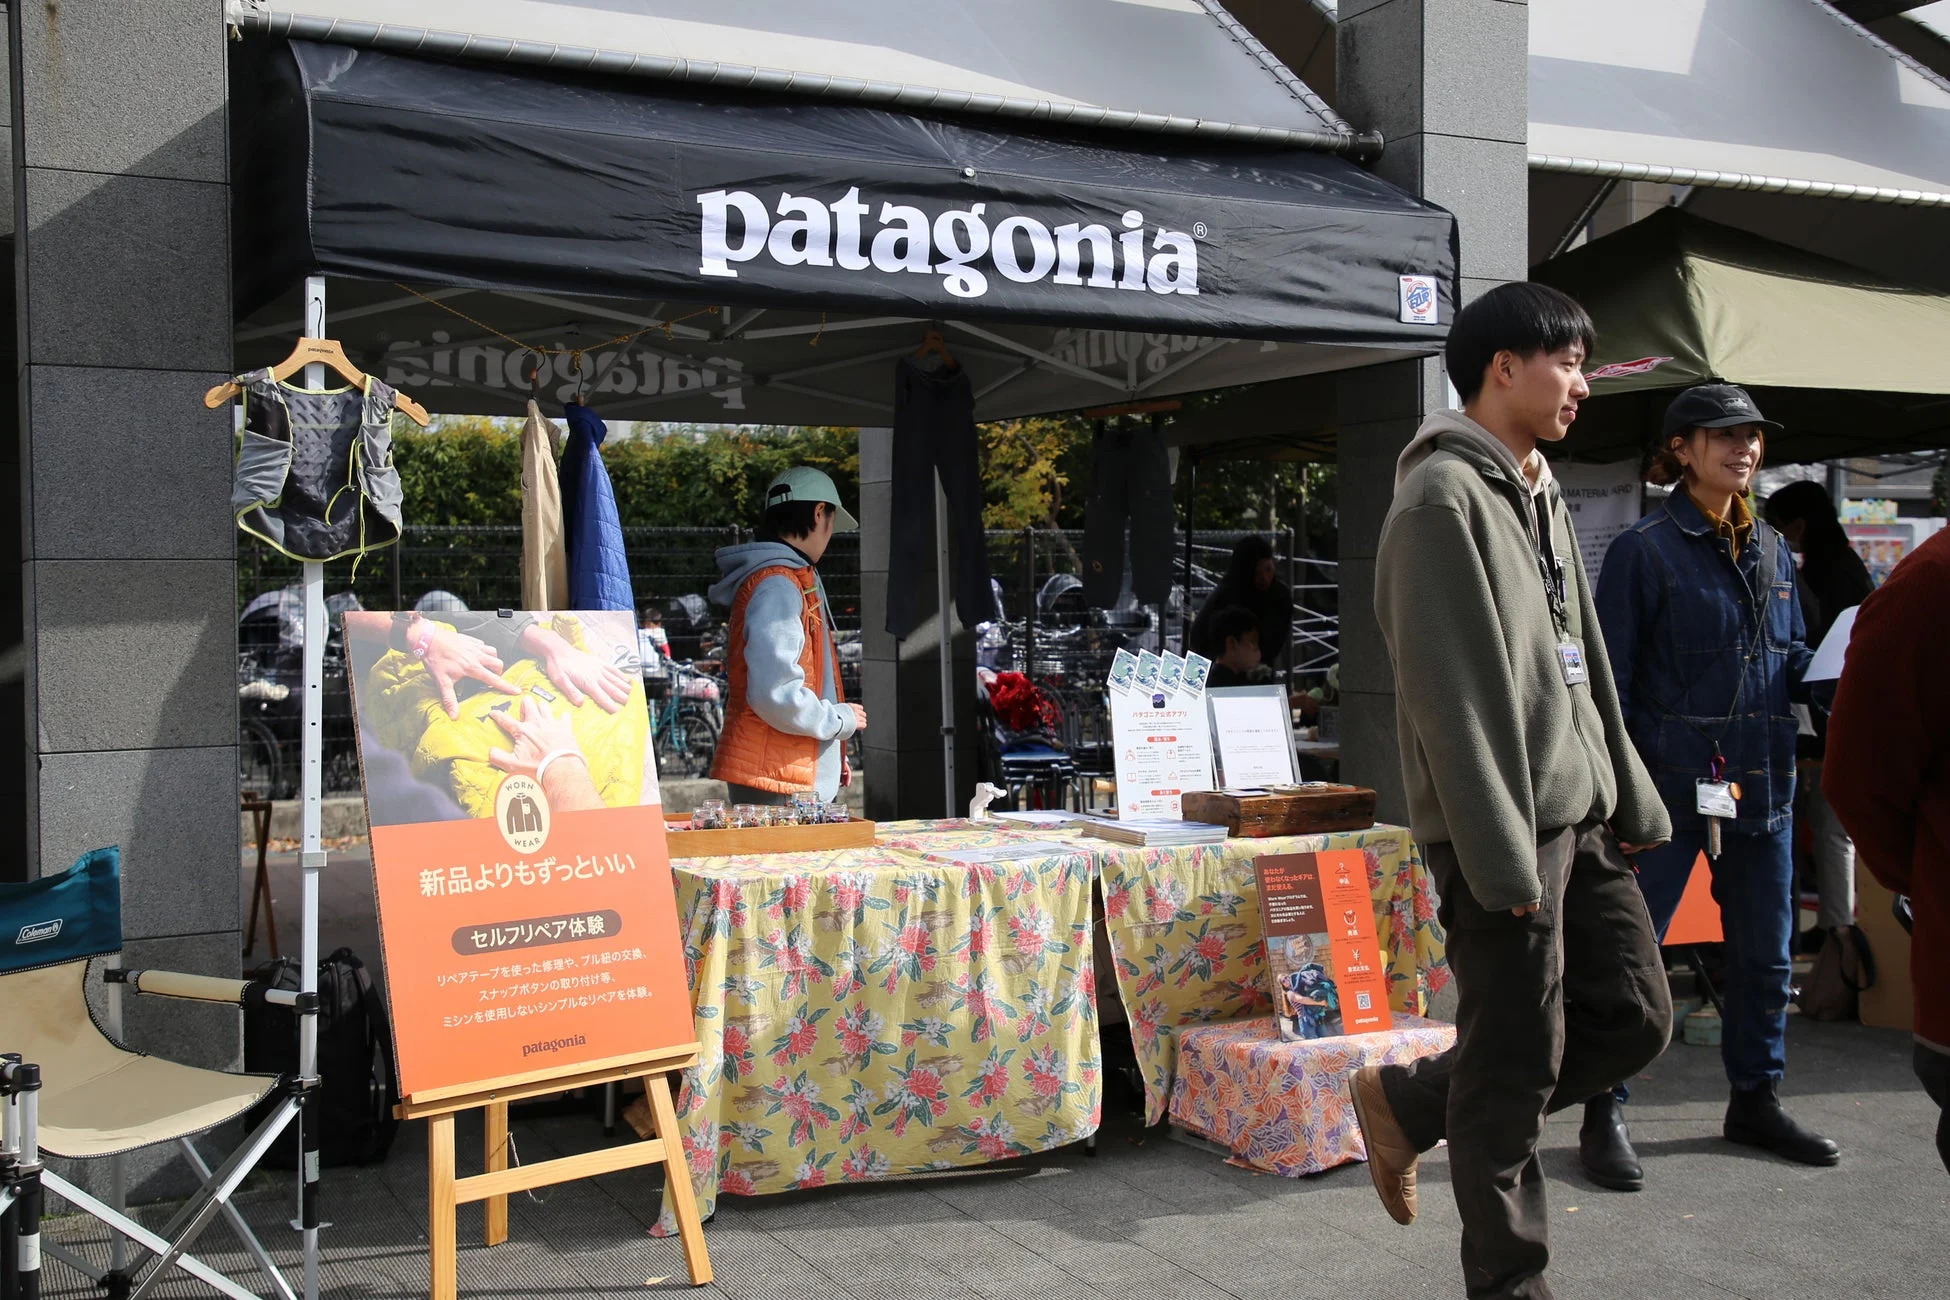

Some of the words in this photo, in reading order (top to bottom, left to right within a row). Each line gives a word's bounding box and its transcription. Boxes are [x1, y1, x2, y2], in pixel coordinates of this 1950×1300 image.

[1612, 484, 1632, 495] ARD
[505, 781, 534, 791] WORN
[514, 837, 540, 847] WEAR
[419, 853, 636, 897] 新品よりもずっといい
[22, 926, 52, 939] Coleman
[470, 915, 605, 949] セルフリペア体験
[479, 972, 616, 1001] スナップボタンの取り付け等、
[443, 986, 653, 1028] ミシンを使用しないシンプルなリペアを体験。
[522, 1034, 586, 1057] patagonia
